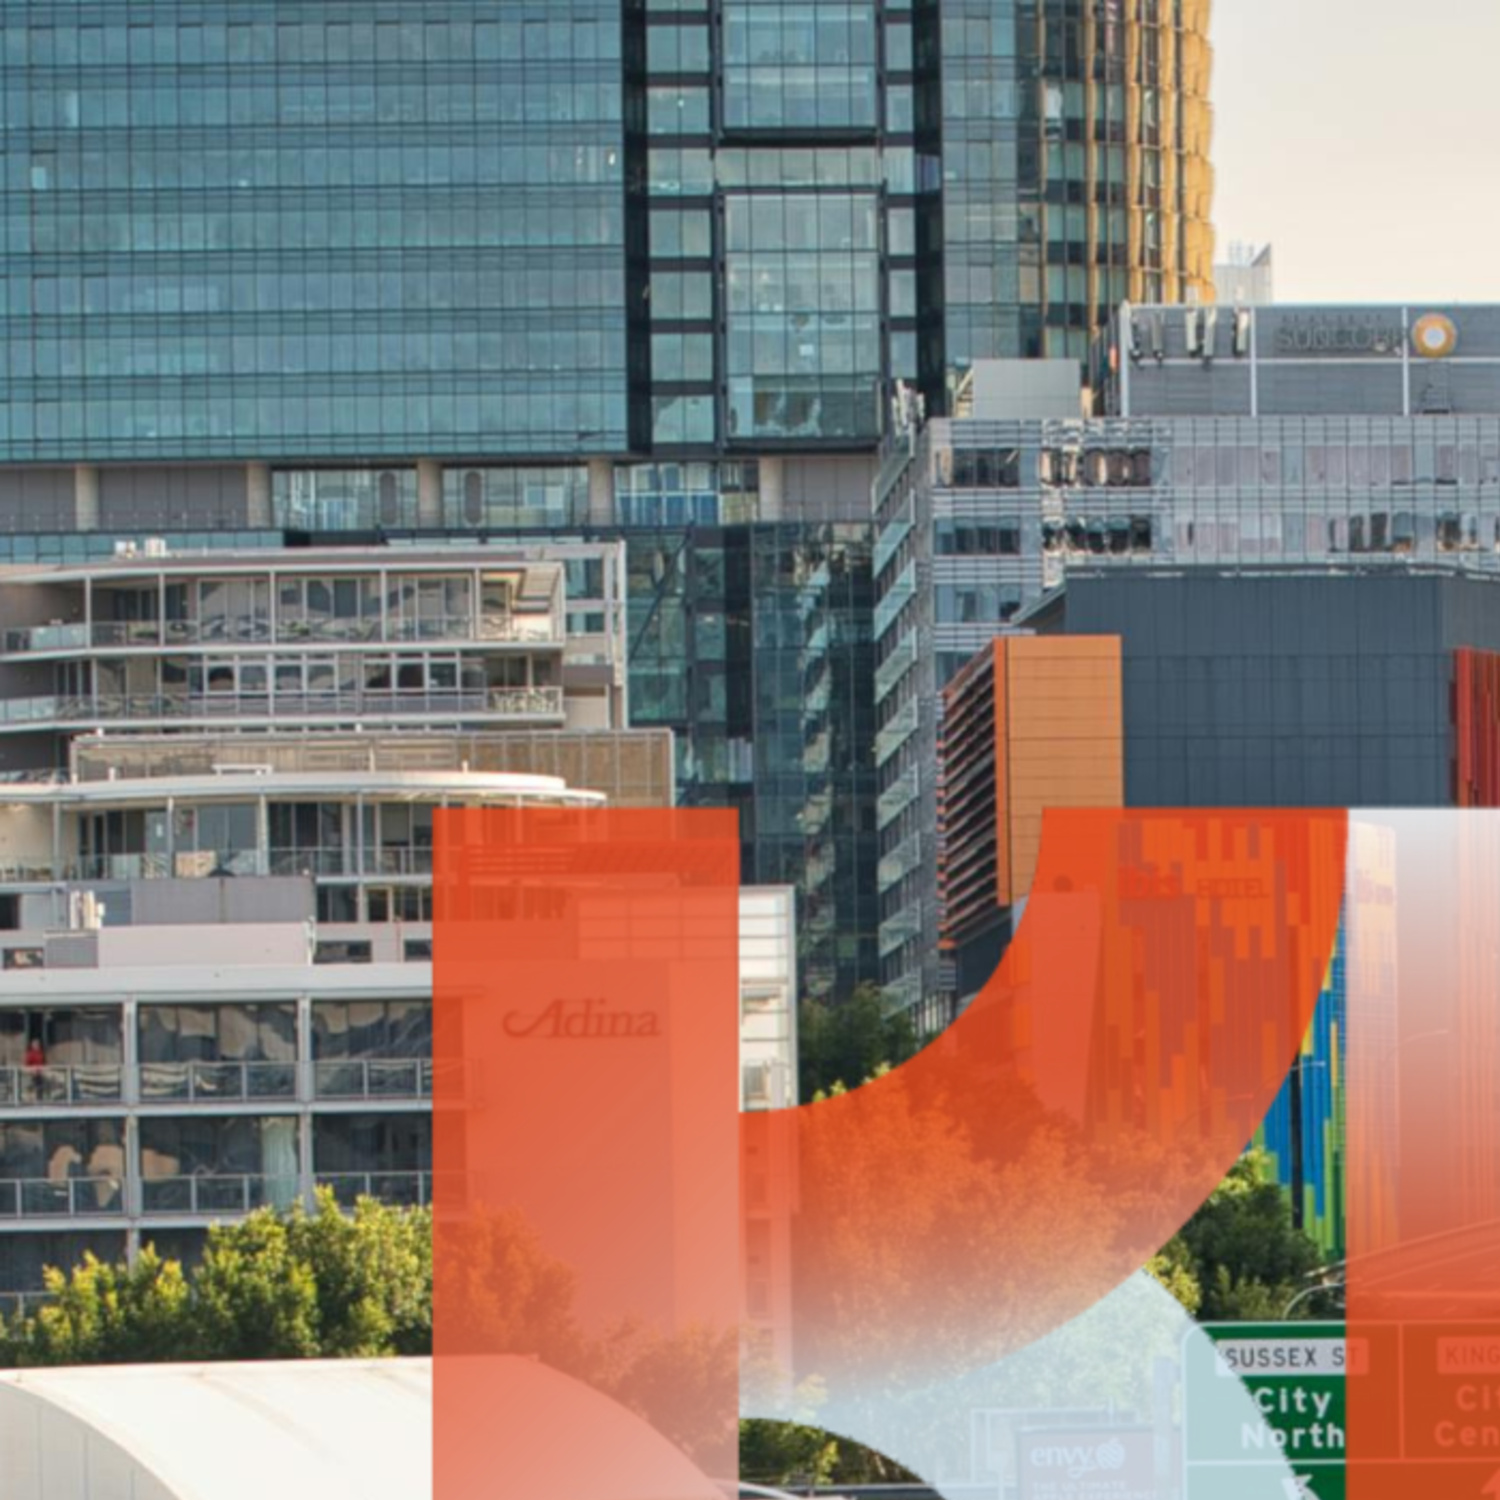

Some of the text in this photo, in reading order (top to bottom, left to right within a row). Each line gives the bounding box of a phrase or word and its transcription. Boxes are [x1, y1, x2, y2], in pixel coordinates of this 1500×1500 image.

[1196, 877, 1269, 899] HOTEL
[502, 998, 661, 1038] Adina
[1225, 1346, 1360, 1367] SUSSEX ST
[1445, 1345, 1500, 1365] KING
[1253, 1386, 1332, 1419] City
[1241, 1423, 1345, 1449] North
[1030, 1446, 1095, 1478] envy
